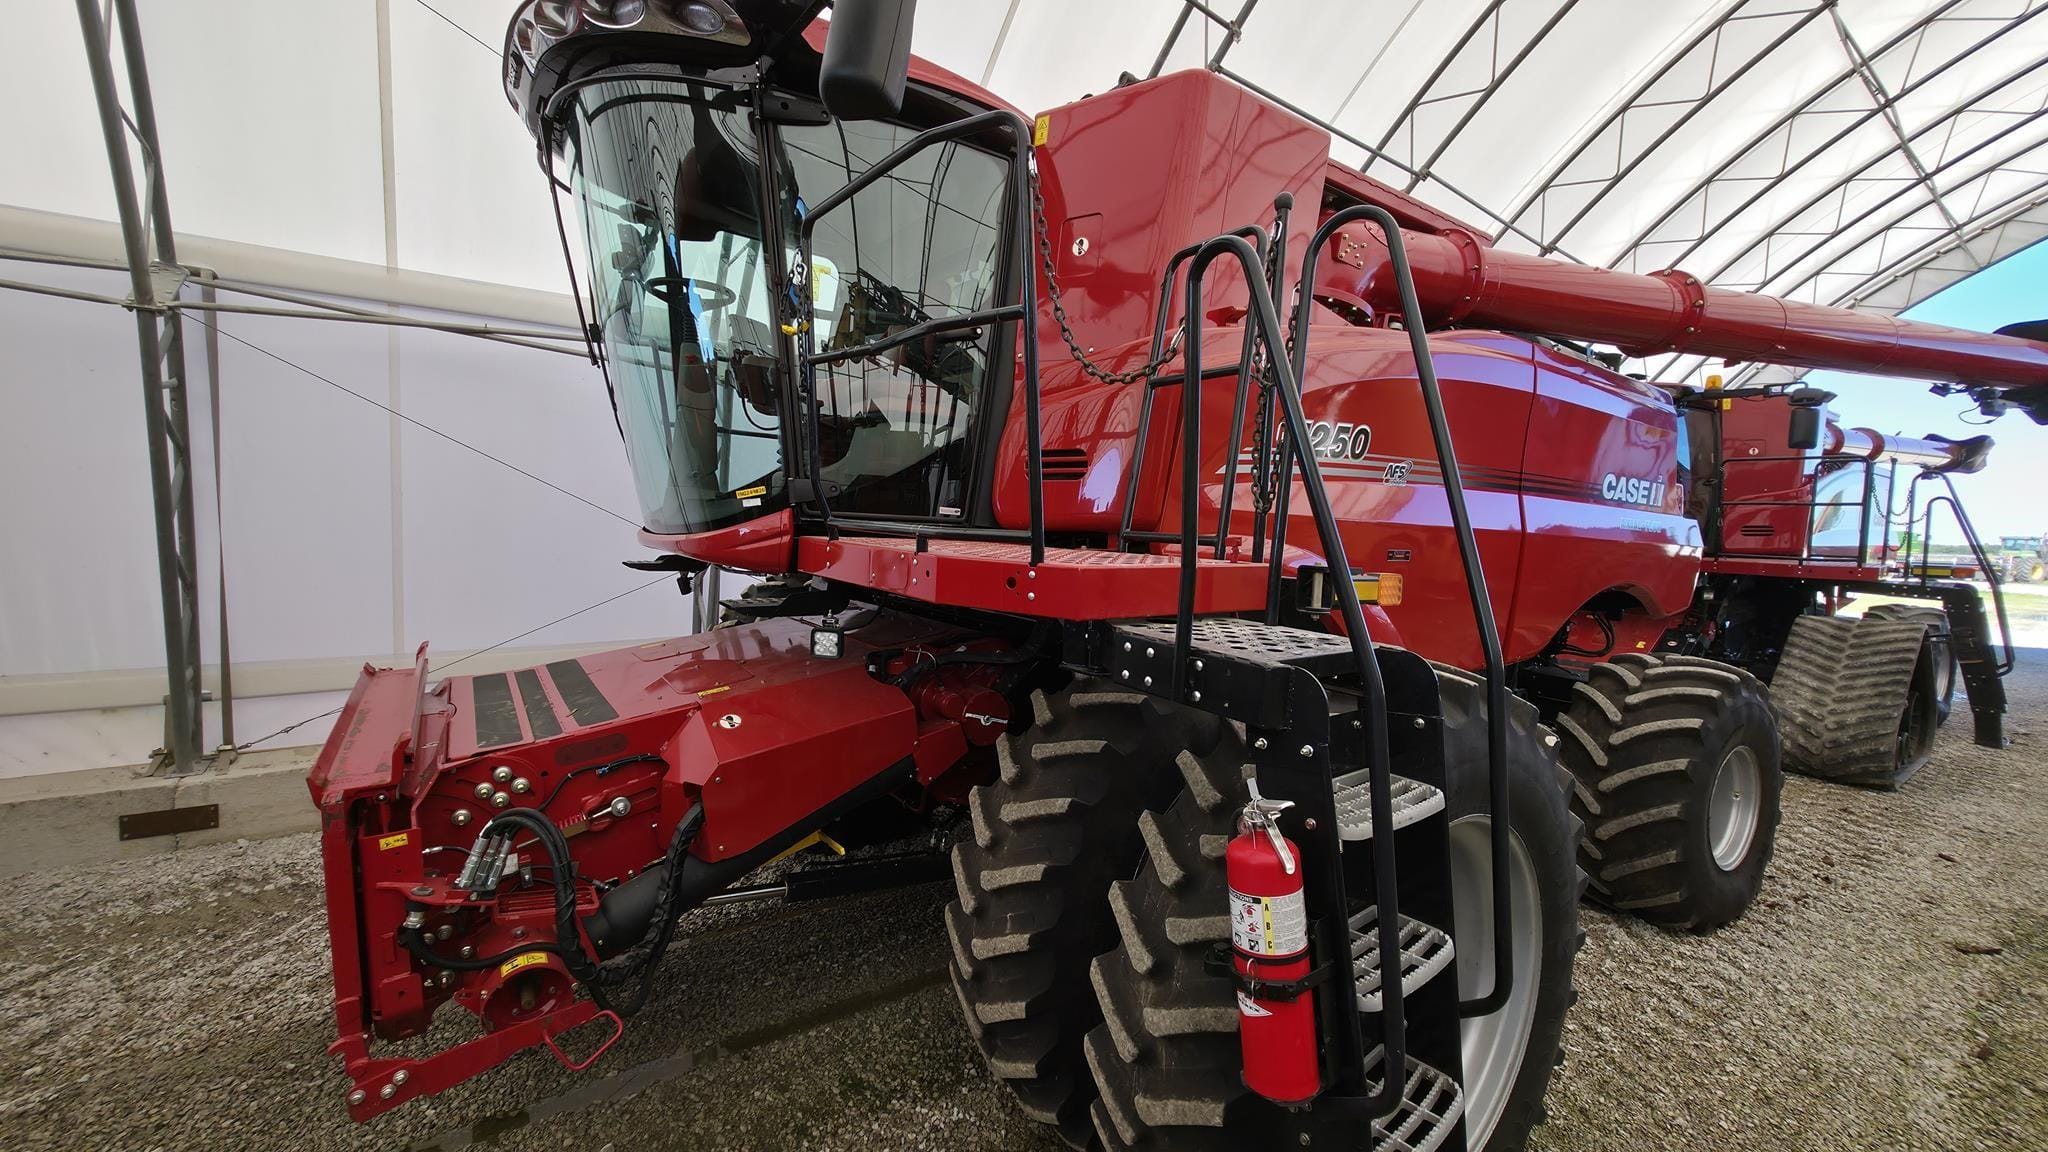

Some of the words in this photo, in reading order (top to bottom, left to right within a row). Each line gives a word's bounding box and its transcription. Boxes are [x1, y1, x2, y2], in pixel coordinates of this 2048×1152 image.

[1304, 419, 1372, 463] 250
[1383, 464, 1407, 479] AFS
[1602, 472, 1650, 505] CASE
[1264, 903, 1270, 912] A
[1265, 922, 1271, 931] B
[1267, 940, 1273, 949] C
